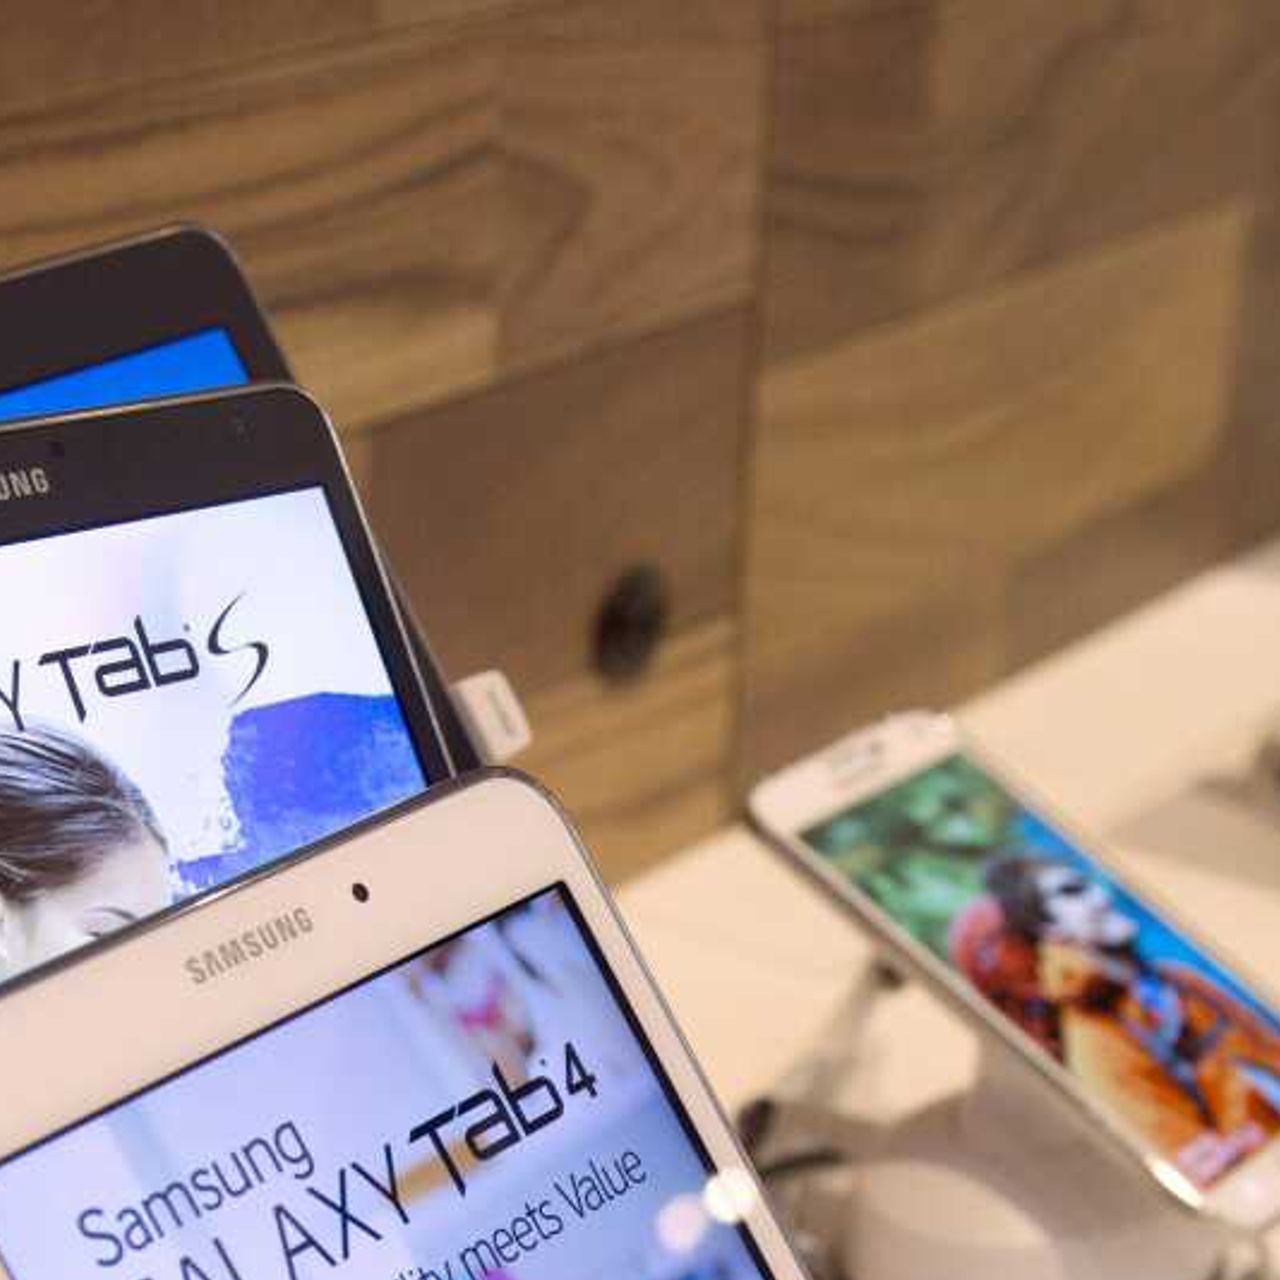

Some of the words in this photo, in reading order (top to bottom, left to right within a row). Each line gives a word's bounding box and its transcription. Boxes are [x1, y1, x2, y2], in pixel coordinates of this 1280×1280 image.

[38, 615, 198, 723] Tab
[185, 907, 313, 985] SAMSUNG
[77, 1119, 314, 1269] Samsung
[552, 1150, 648, 1221] Value
